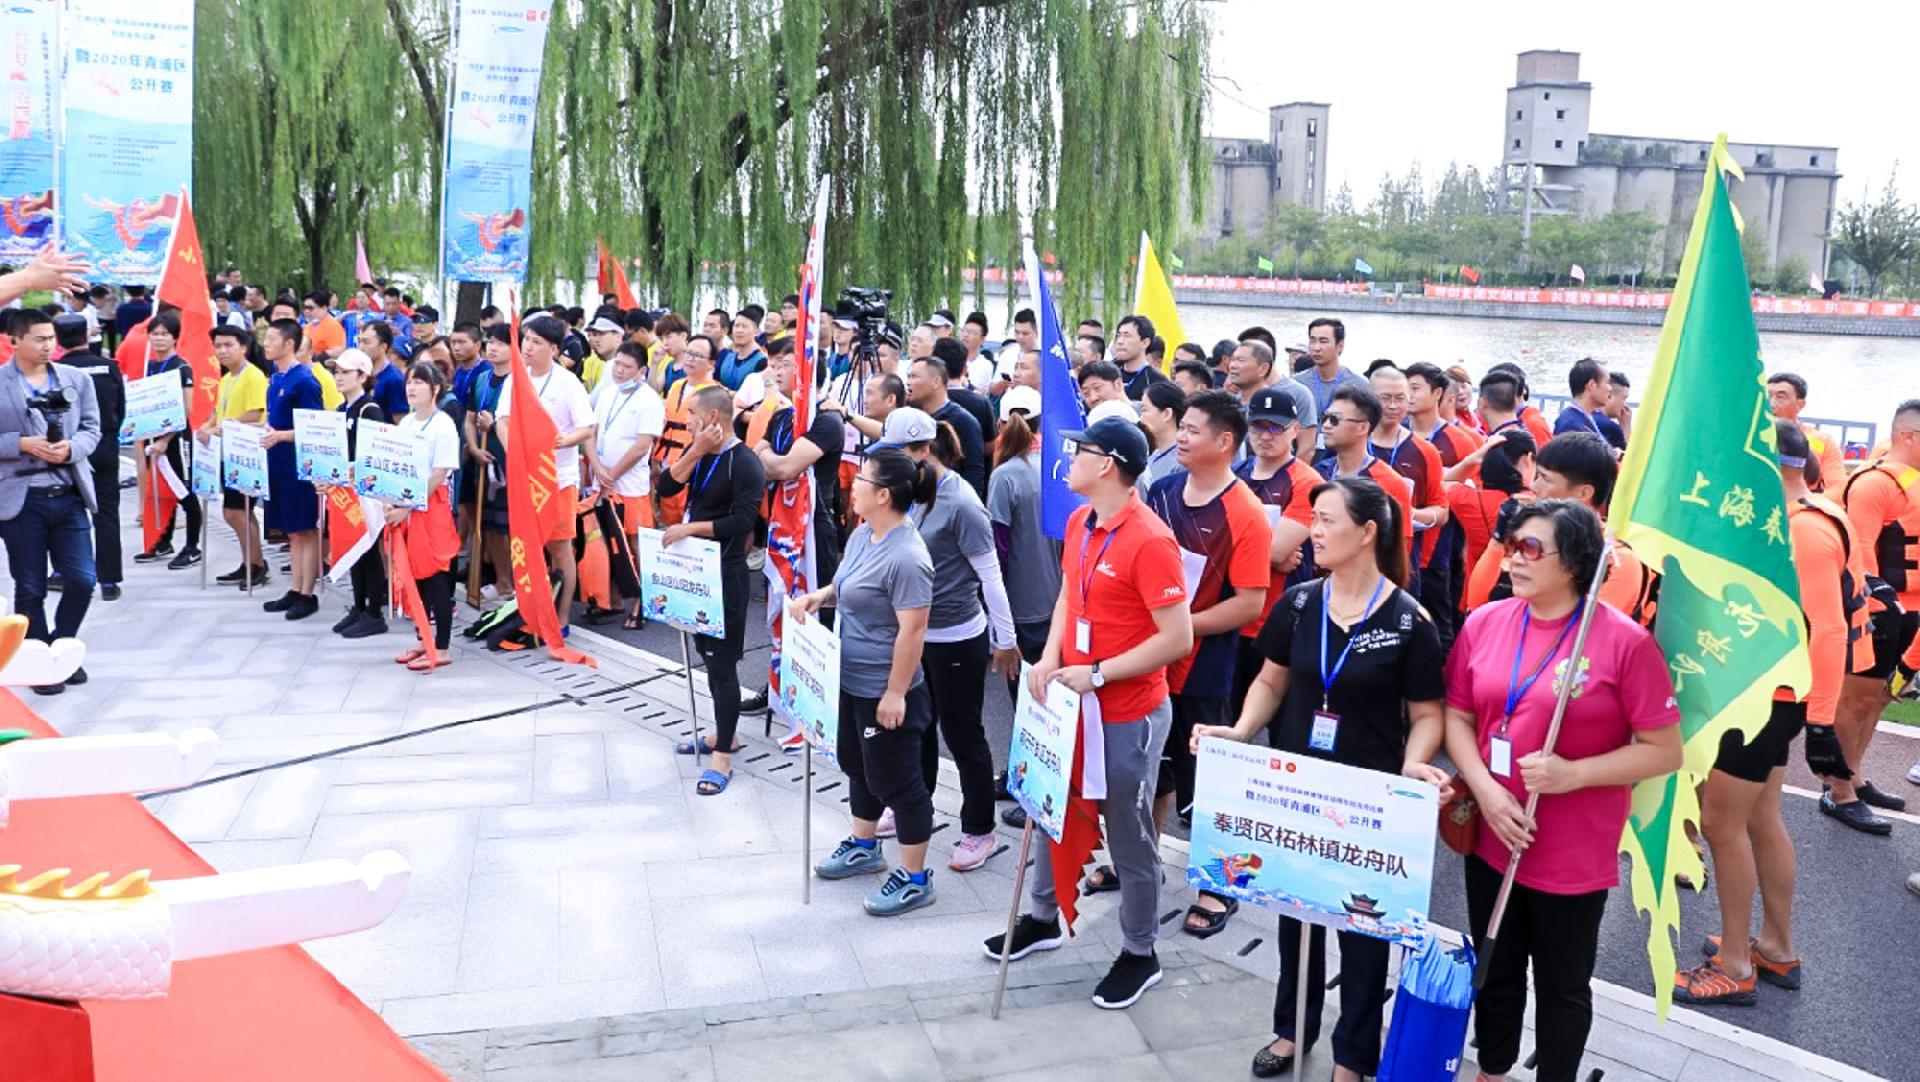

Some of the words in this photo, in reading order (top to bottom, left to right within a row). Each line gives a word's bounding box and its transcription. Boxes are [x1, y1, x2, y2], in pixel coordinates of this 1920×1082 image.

[1213, 811, 1408, 879] 奉贤区柘林镇龙舟队
